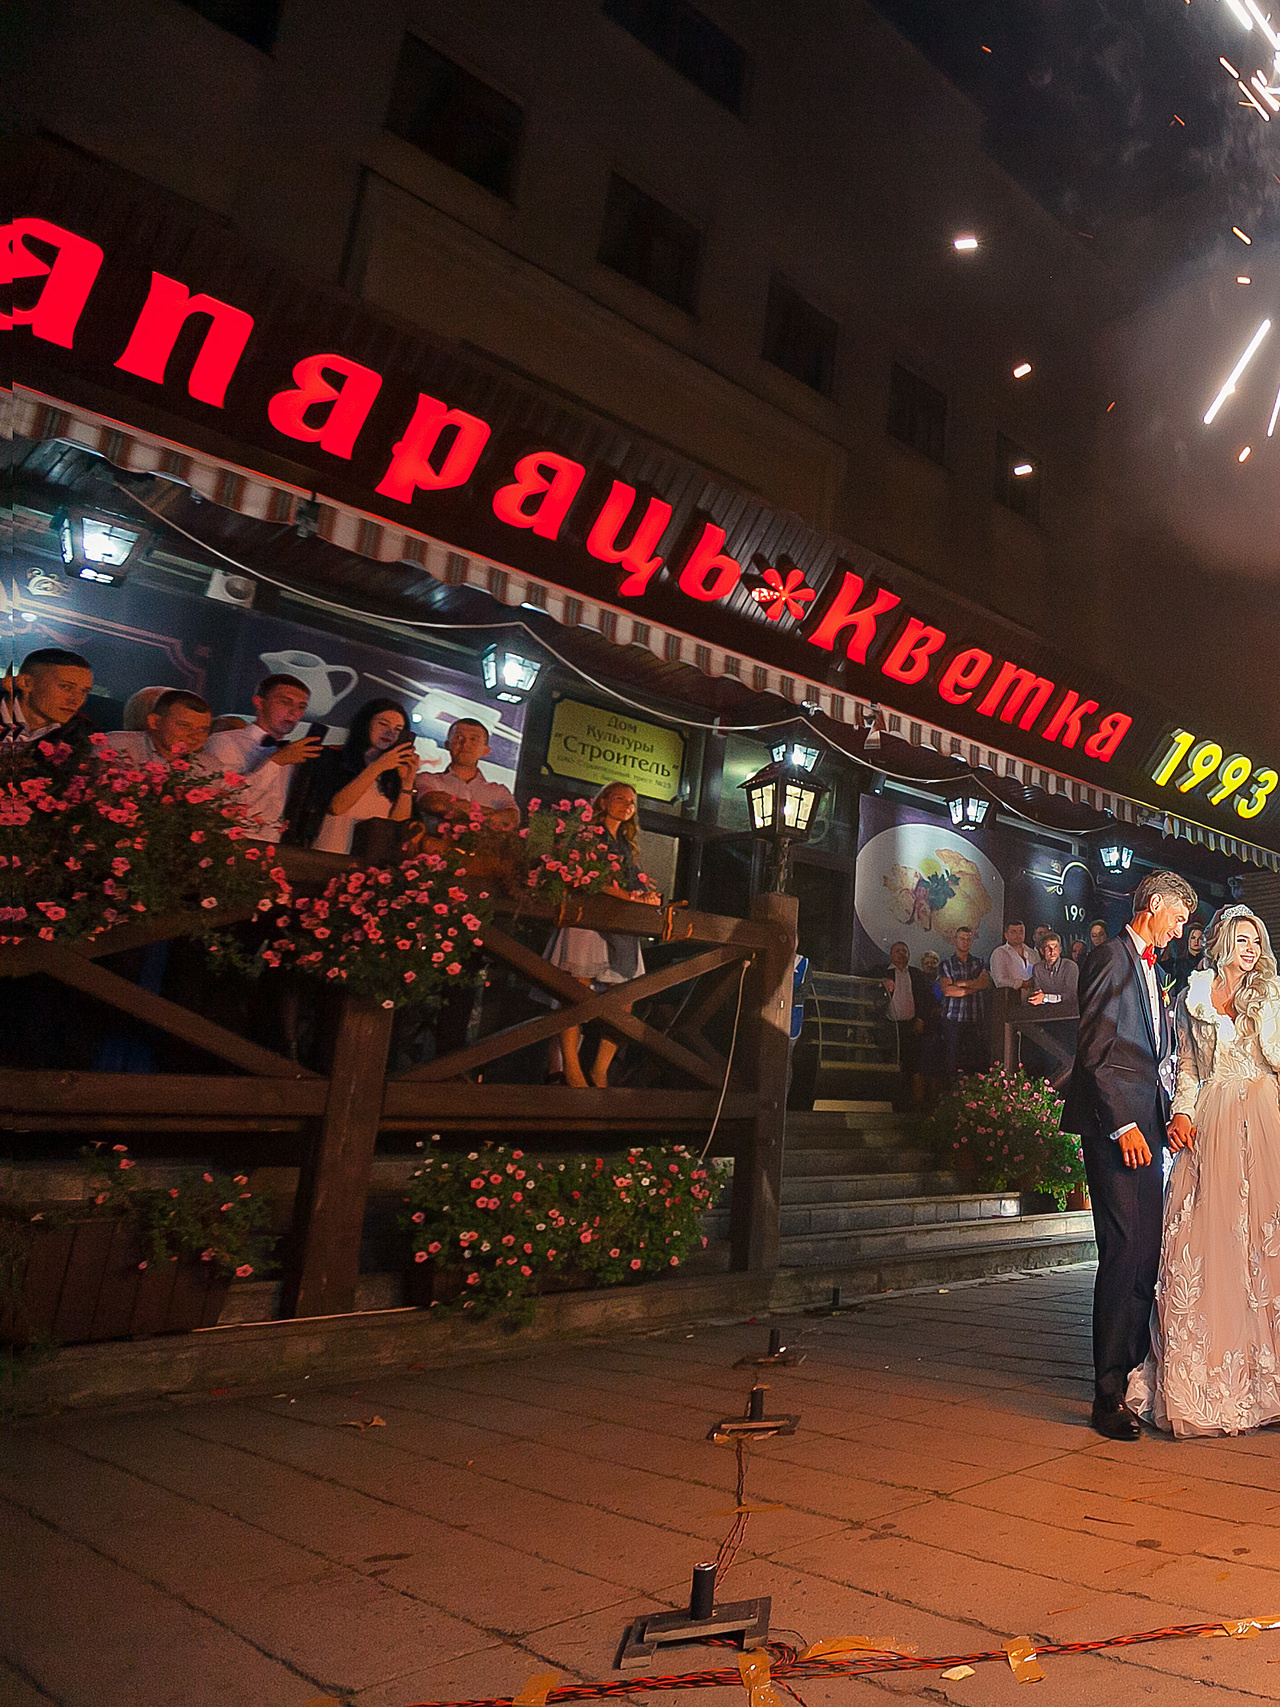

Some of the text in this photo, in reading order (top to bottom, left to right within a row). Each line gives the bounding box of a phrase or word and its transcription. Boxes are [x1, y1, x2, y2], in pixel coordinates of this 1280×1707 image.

[808, 570, 1133, 763] Кветка
[586, 724, 654, 753] Культуры
[607, 716, 638, 734] Дом
[1151, 727, 1280, 820] 1993
